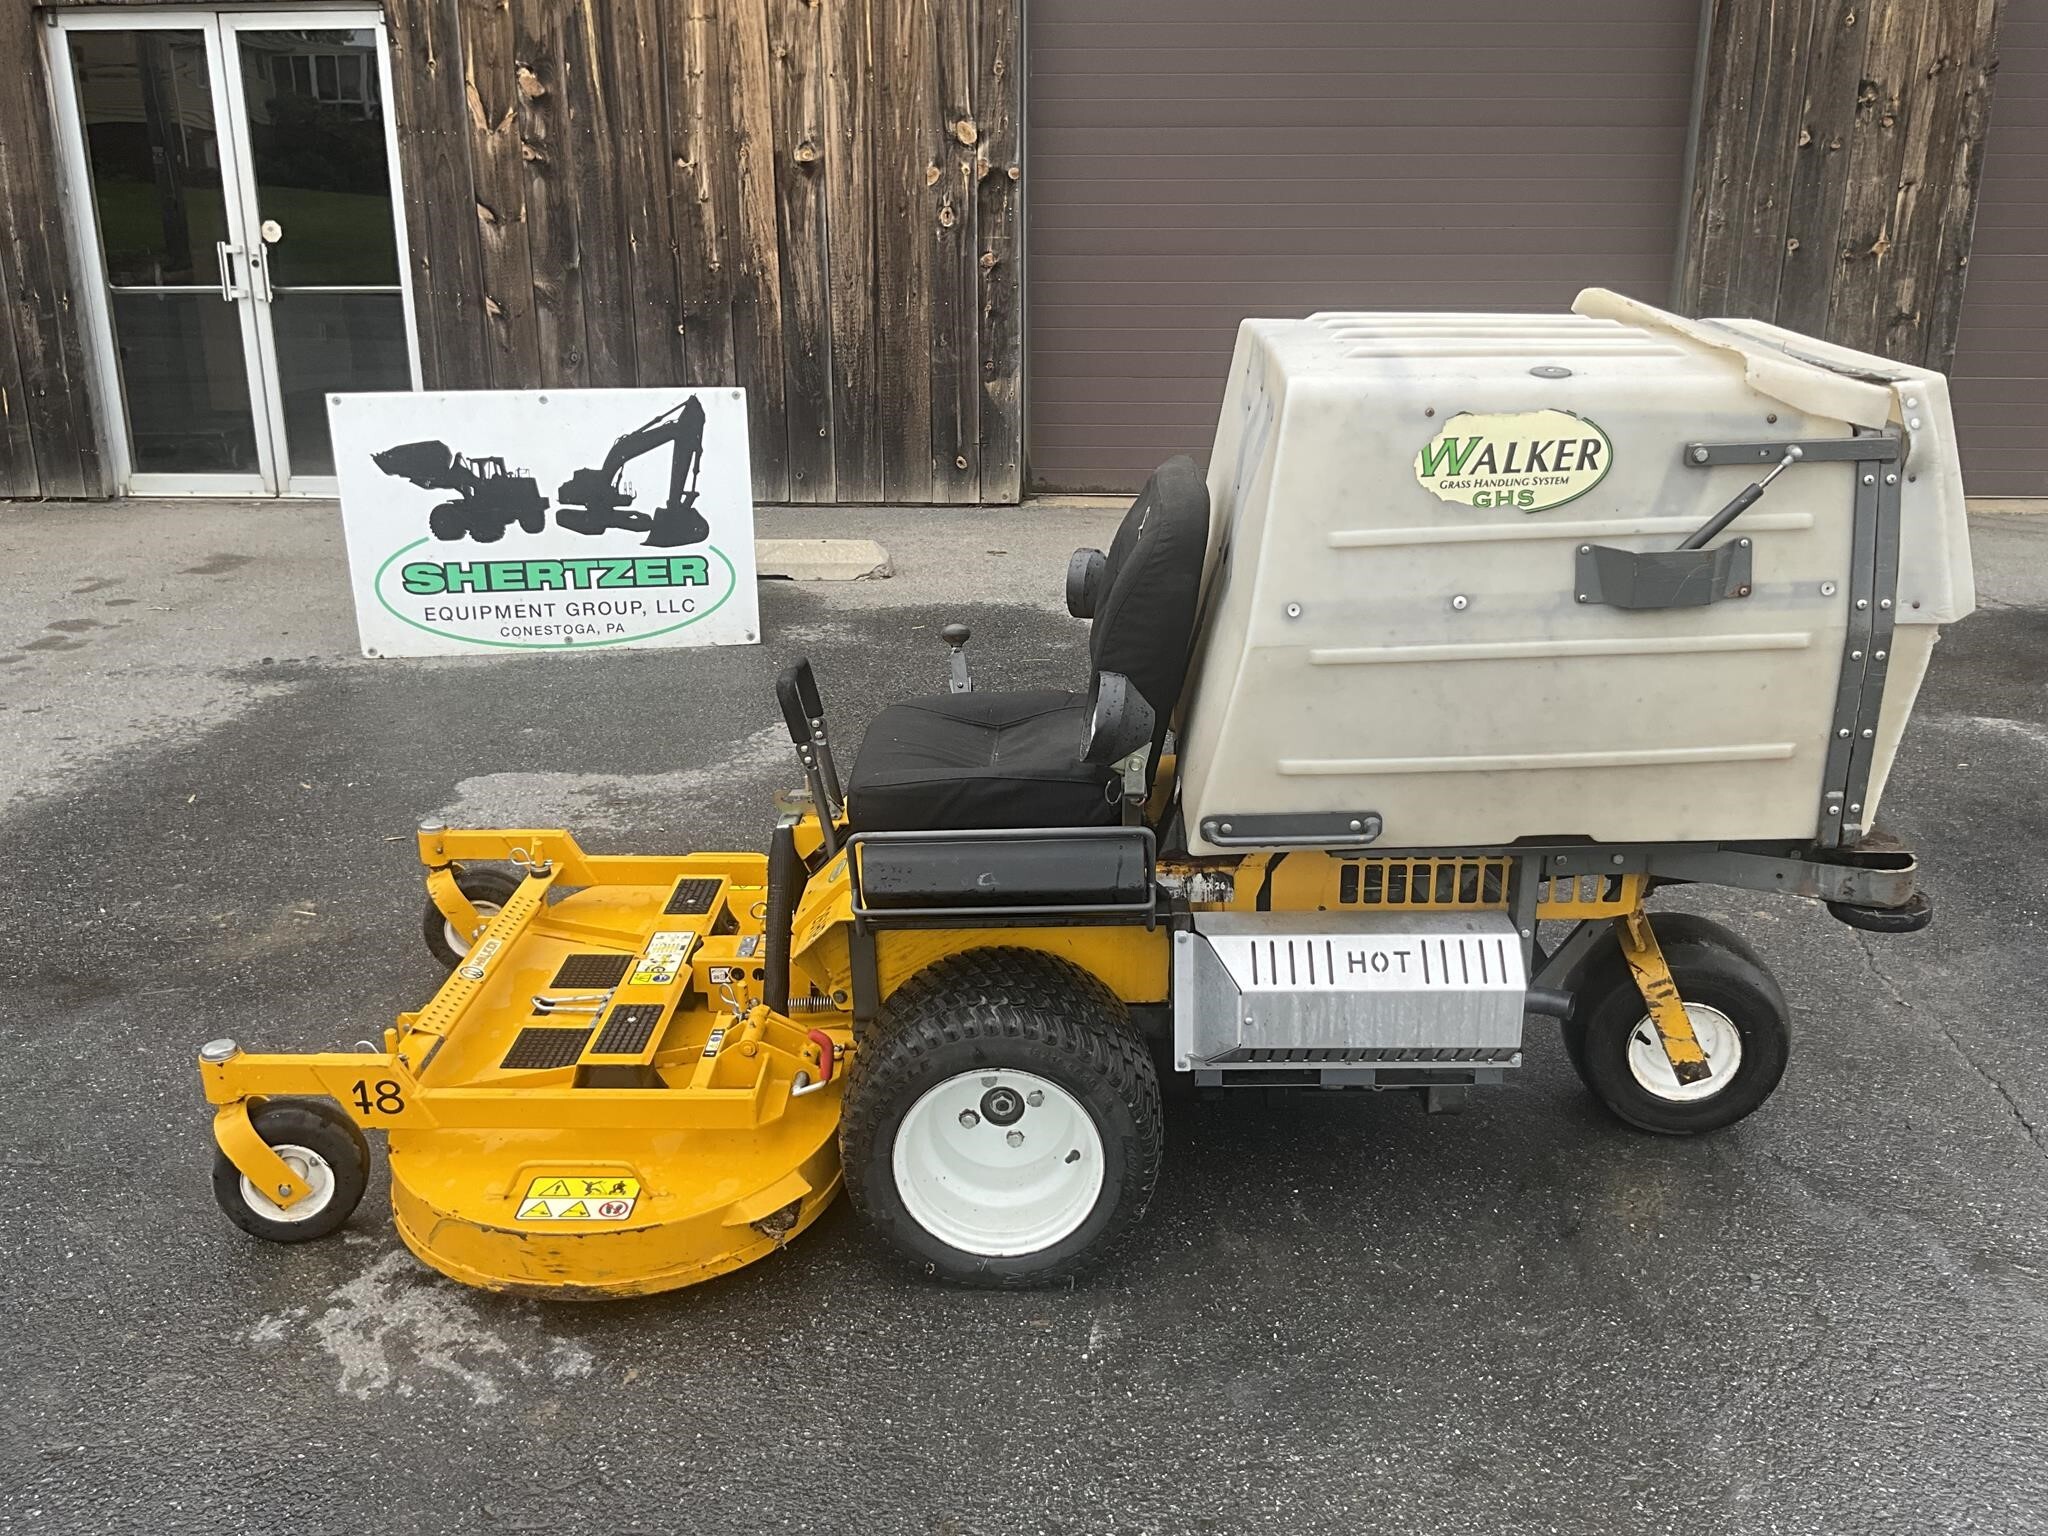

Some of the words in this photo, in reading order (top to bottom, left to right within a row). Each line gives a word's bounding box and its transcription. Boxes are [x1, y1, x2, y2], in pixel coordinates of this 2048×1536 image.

[1420, 436, 1602, 478] WALKER
[1439, 480, 1472, 490] GRASS
[1473, 478, 1531, 489] HANDLING
[1532, 476, 1570, 487] SYSTEM
[1472, 489, 1535, 508] GHS
[401, 554, 709, 595] SHERTZER
[424, 603, 556, 622] EQUIPMENT
[565, 600, 647, 617] GROUP,
[656, 598, 696, 614] LLC
[500, 624, 600, 637] CONESTOGA,
[606, 623, 625, 634] PA
[1346, 951, 1411, 973] HOT
